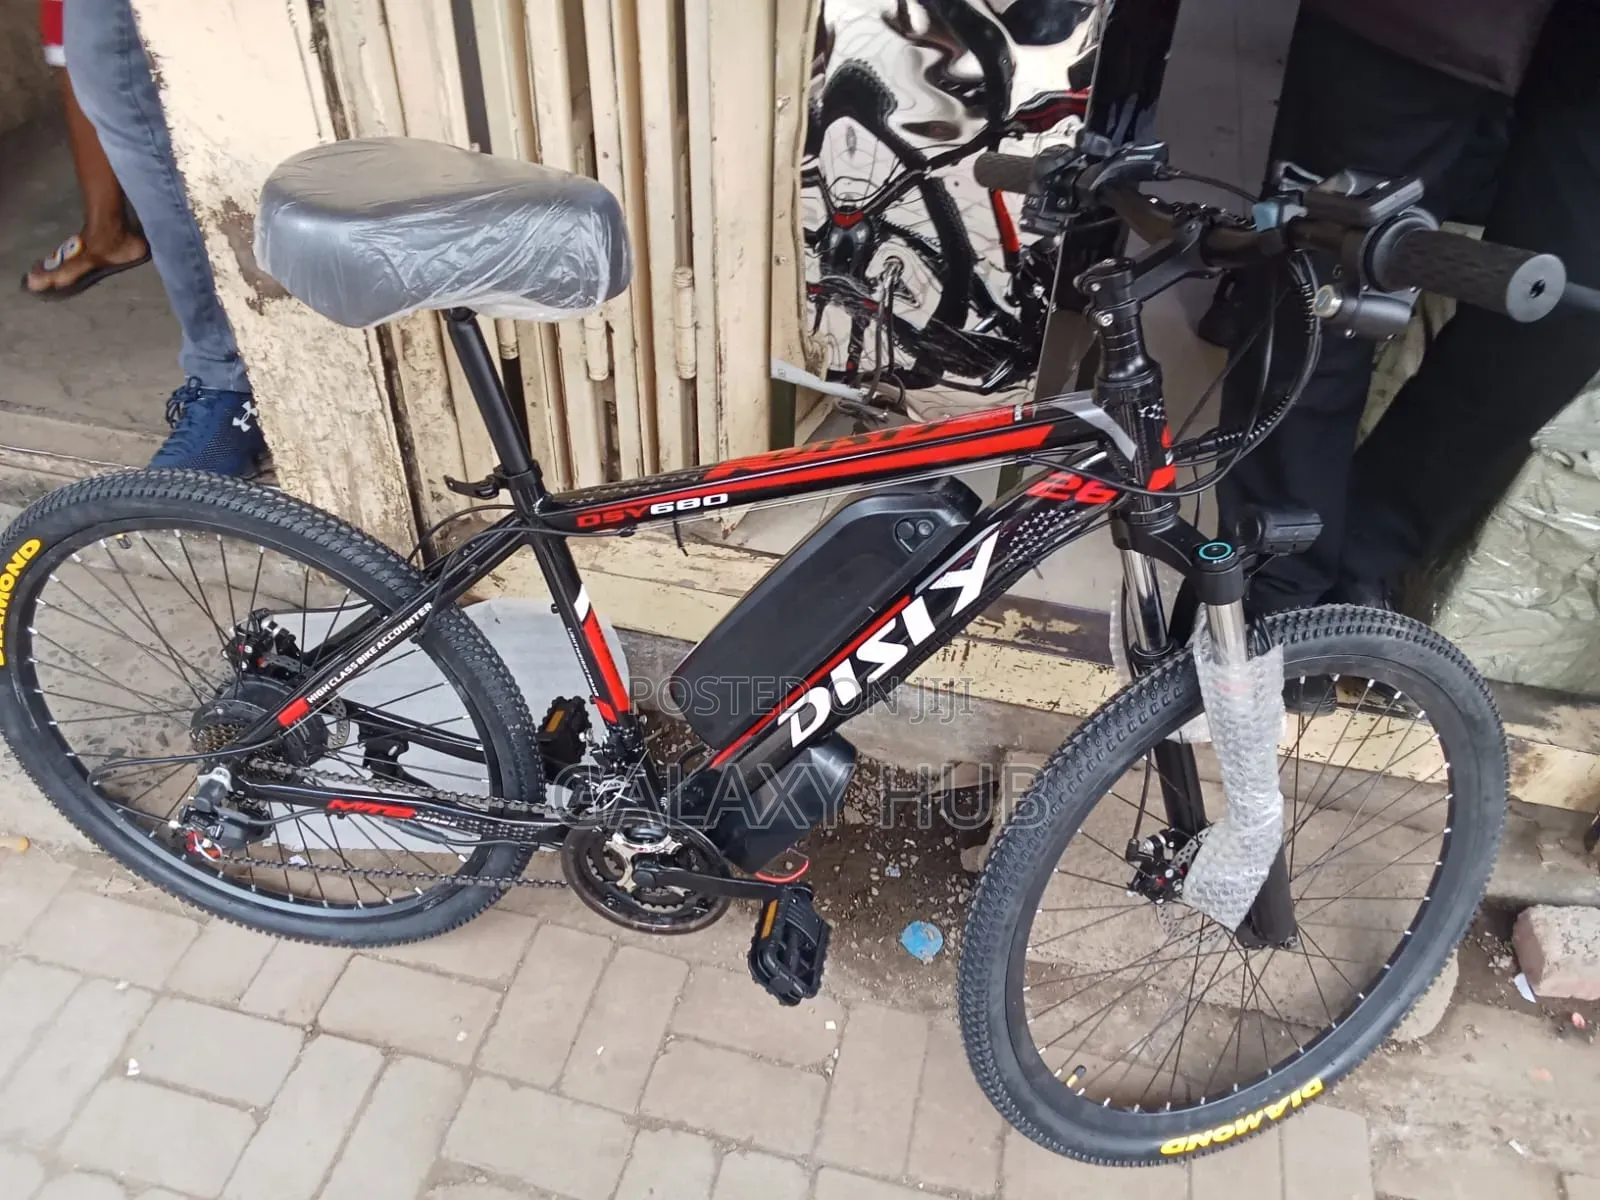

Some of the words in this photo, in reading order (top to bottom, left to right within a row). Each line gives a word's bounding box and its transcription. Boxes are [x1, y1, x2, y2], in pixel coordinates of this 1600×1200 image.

[1024, 471, 1119, 504] 26
[306, 685, 331, 704] HIGH
[328, 662, 359, 687] CLASS
[355, 646, 379, 668] BIKE
[376, 602, 433, 650] ACCOUNTER
[1160, 1077, 1324, 1155] DIAMOND
